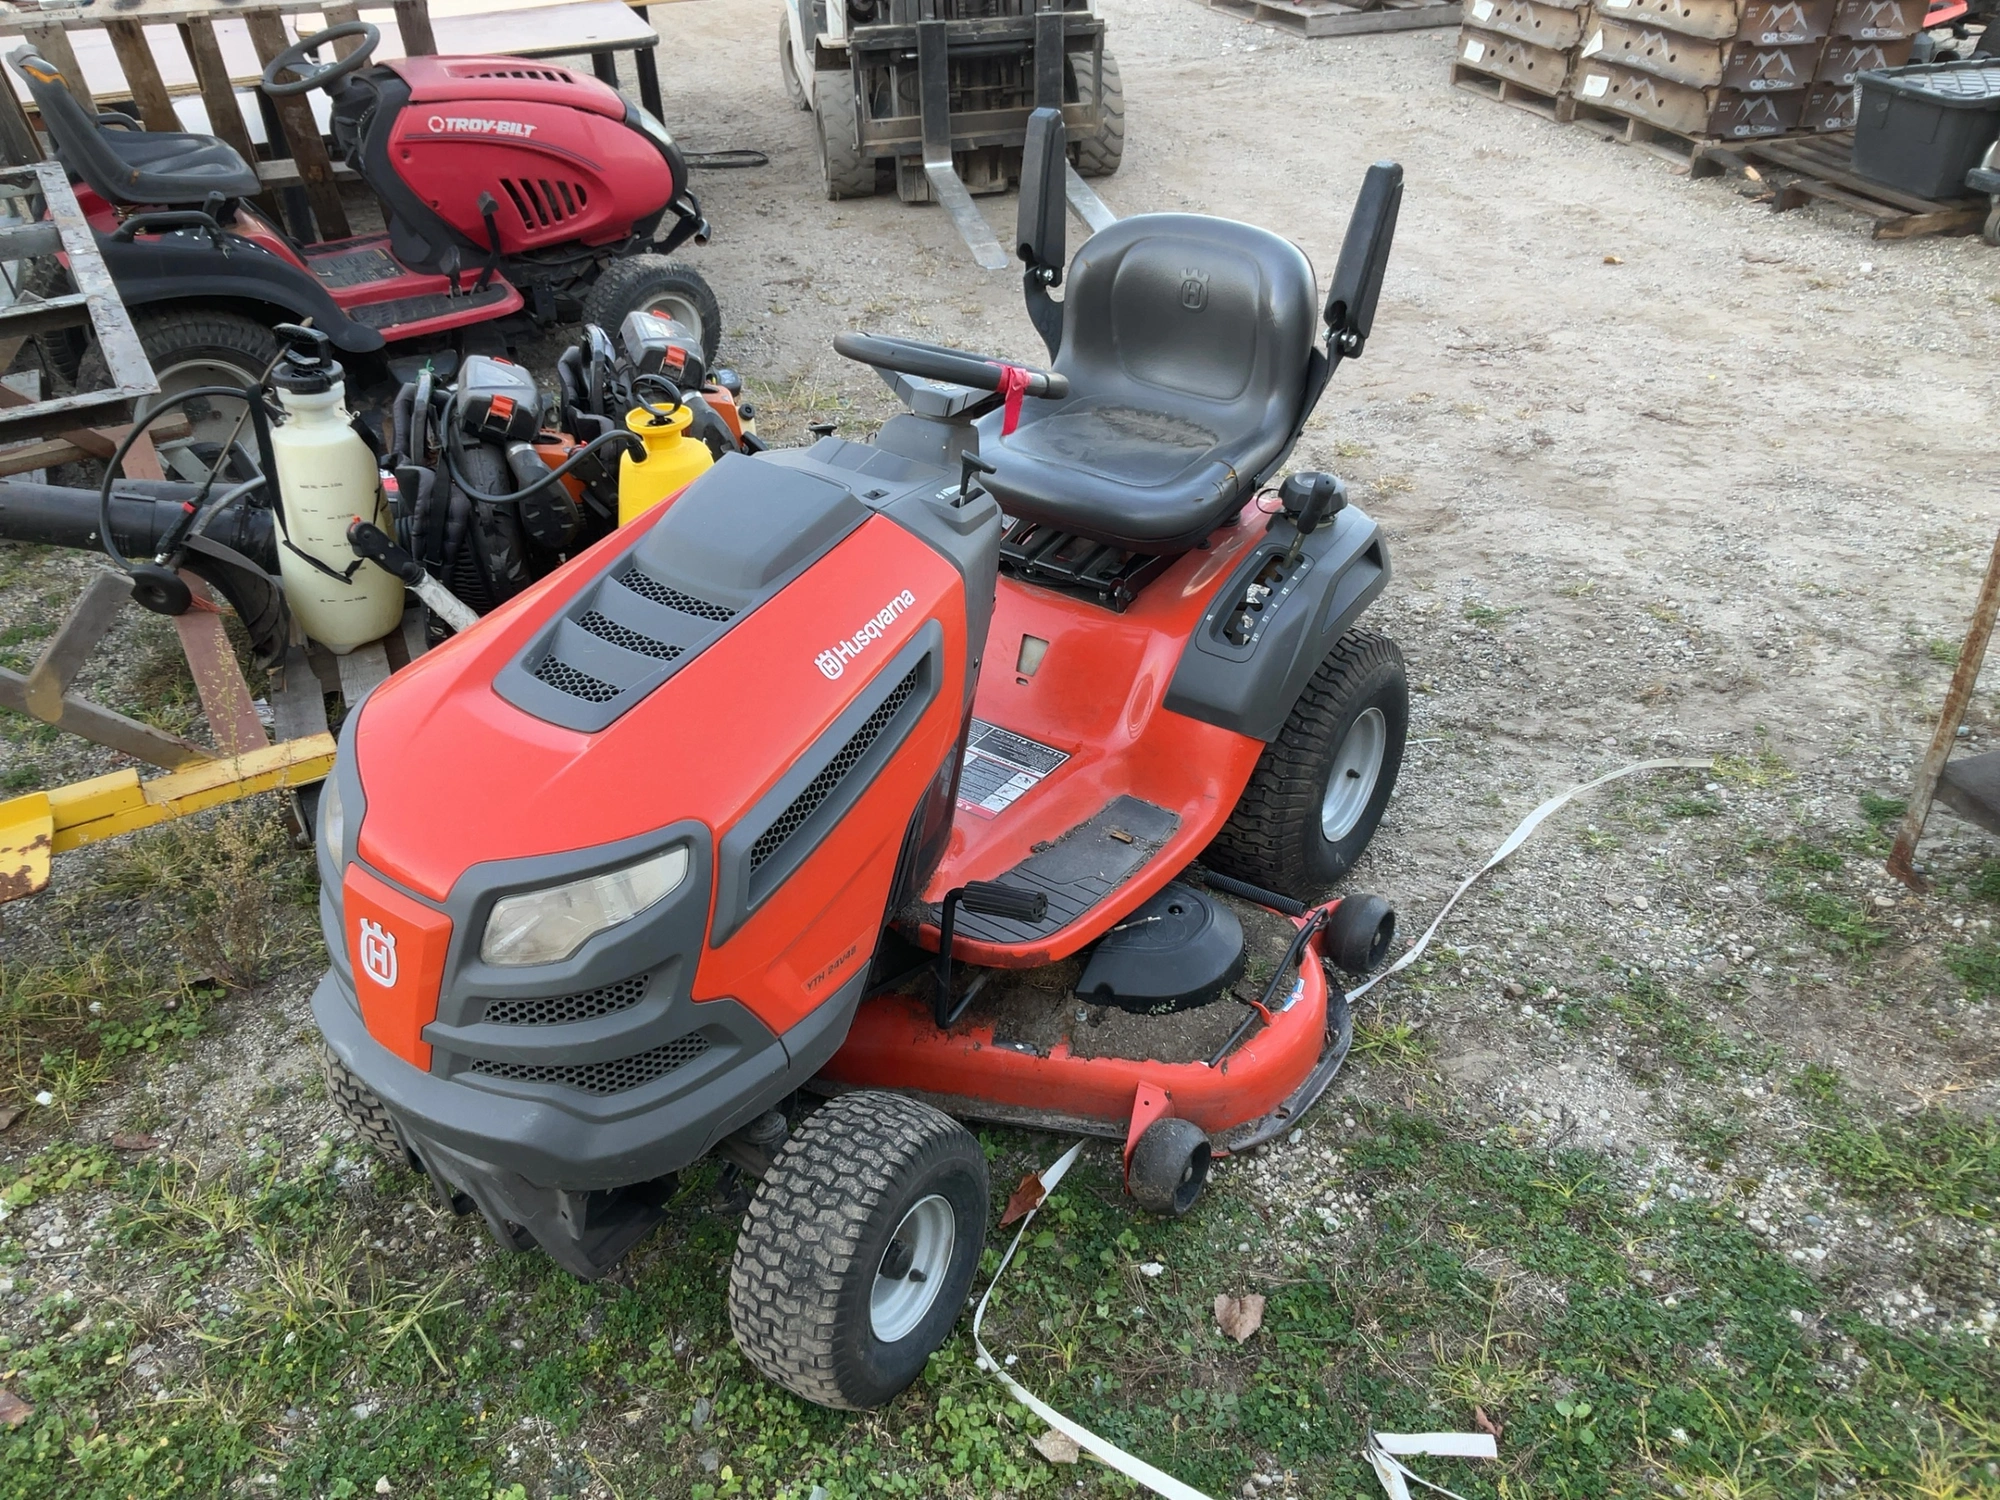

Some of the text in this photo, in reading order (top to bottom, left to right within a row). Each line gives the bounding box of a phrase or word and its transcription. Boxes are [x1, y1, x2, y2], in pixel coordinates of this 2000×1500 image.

[1761, 32, 1778, 43] QR
[1861, 28, 1876, 38] QR
[1749, 79, 1766, 90] QR
[445, 117, 537, 138] TROY-BILT
[1825, 118, 1841, 128] QR
[1734, 124, 1750, 135] QR
[832, 589, 916, 665] Husqvarna
[807, 972, 825, 991] YTH
